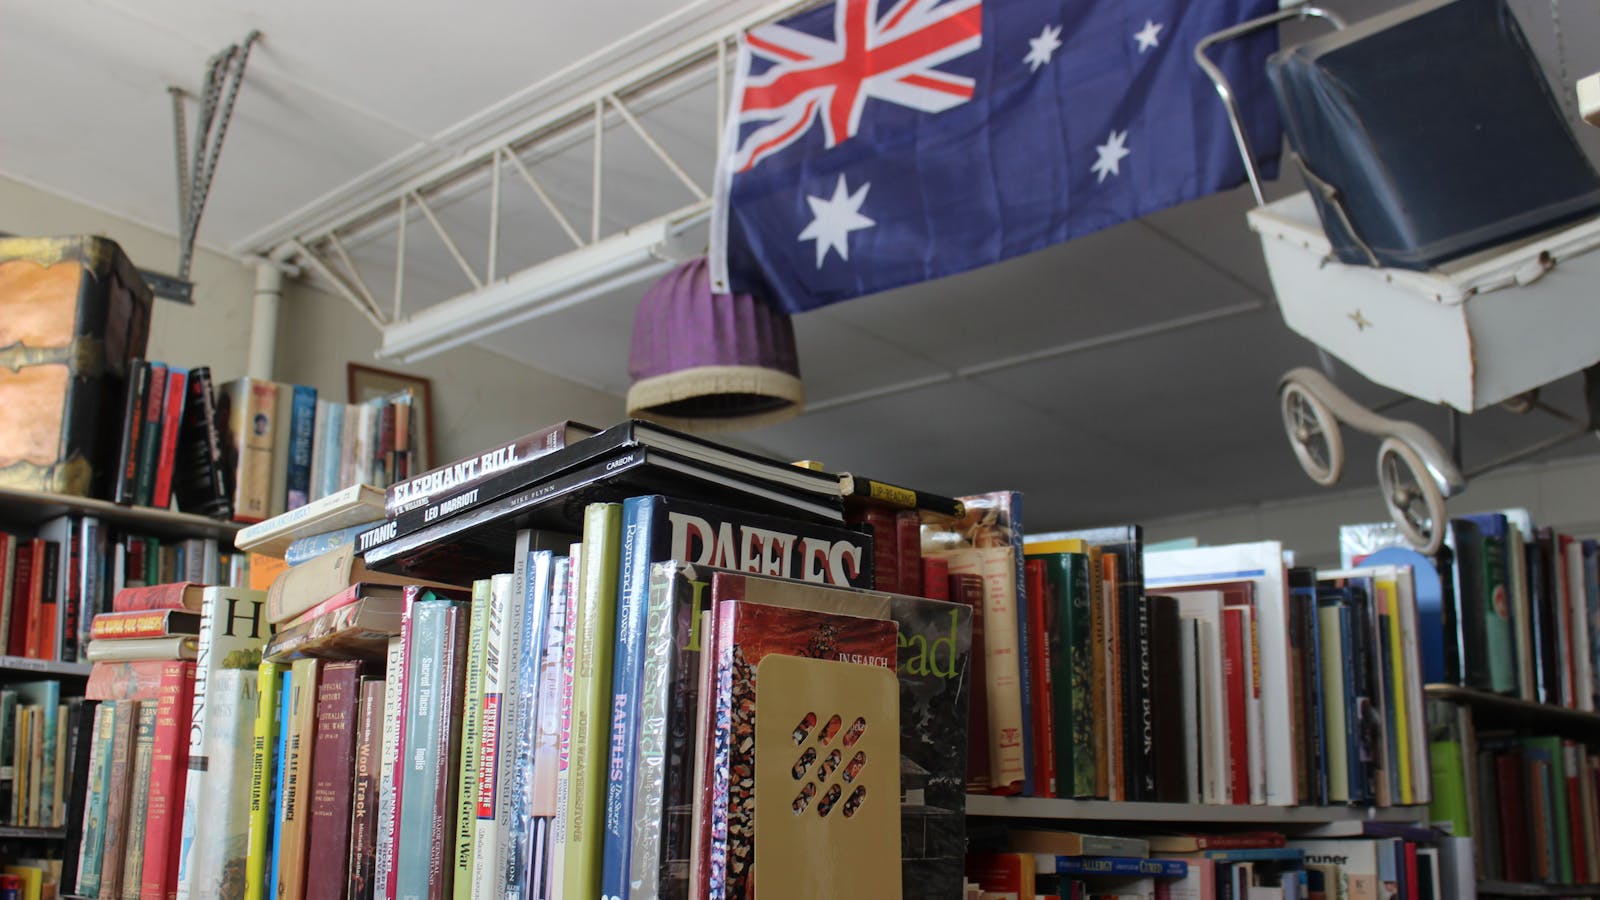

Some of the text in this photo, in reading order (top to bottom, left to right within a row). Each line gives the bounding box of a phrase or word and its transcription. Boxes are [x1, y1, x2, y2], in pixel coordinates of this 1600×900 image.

[393, 443, 519, 506] ELEPHANT BILL
[511, 484, 556, 507] MIKE FLYNN
[423, 488, 479, 523] LEO MARRIOTT
[359, 520, 398, 551] TITANIC
[618, 523, 637, 644] Raymond Flower
[189, 599, 213, 747] HUNTING
[839, 652, 889, 669] IN SEARCH
[1138, 595, 1153, 755] THE BODY BOOK
[418, 656, 433, 717] Sacred Places
[501, 559, 524, 827] FROM DUNTROON TO THE DARDANELLES
[256, 735, 265, 752] THE
[291, 733, 301, 752] THE
[380, 649, 400, 834] DIGGERS IN FRANCE
[458, 594, 487, 871] The Australian People and the Great War
[559, 672, 575, 772] AUSTRALIA
[610, 692, 628, 781] RAFFLES
[289, 774, 298, 785] IN
[359, 743, 371, 777] Wool
[414, 747, 426, 771] Inglis
[479, 745, 487, 778] WORLD
[482, 702, 497, 809] AUSTRALIA DURING THE
[251, 752, 264, 812] AUSTRALIANS
[285, 786, 297, 823] FRANCE
[356, 780, 369, 818] Track
[388, 786, 397, 831] LENNARD
[380, 842, 388, 891] RICHARD
[433, 815, 443, 876] MAJOR GENERAL
